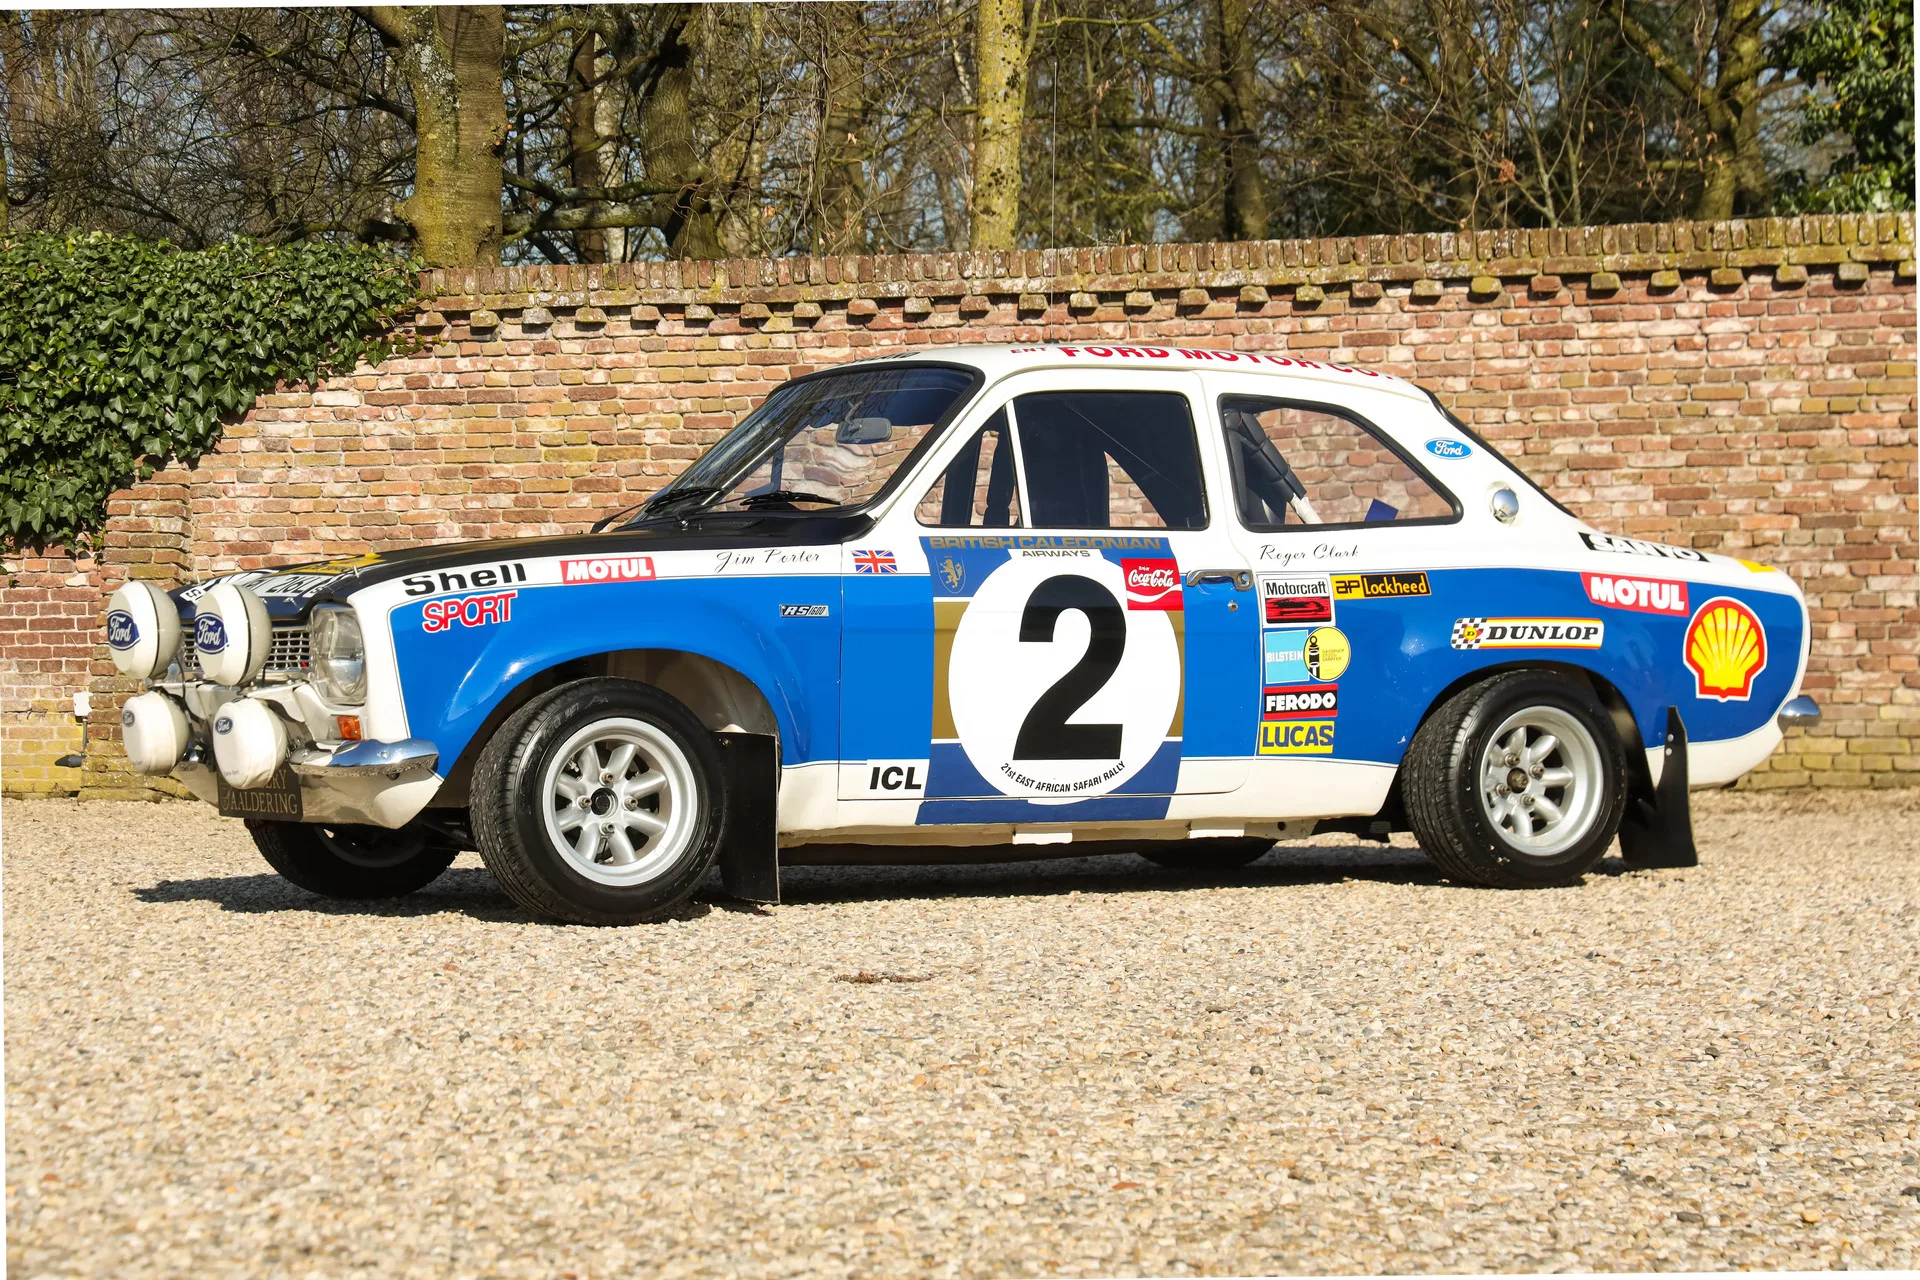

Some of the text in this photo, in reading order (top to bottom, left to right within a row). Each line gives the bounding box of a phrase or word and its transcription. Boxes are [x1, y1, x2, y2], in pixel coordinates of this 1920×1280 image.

[1058, 346, 1170, 358] FORD
[1177, 348, 1321, 369] MOTOR
[1434, 440, 1464, 456] Ford
[929, 536, 1161, 549] BRITISH CALEDONIAN
[1022, 549, 1091, 558] AIRWAYS
[1588, 533, 1701, 562] SANYO
[714, 549, 820, 573] Jim Porter
[1259, 543, 1359, 567] Roger Clark
[402, 563, 527, 596] Shell
[565, 558, 652, 581] MOTUL
[1128, 569, 1174, 588] Coca-Cola
[1265, 581, 1328, 596] Motorcraft
[1363, 575, 1427, 595] Lockheed
[1590, 576, 1685, 611] MOTUL
[423, 591, 517, 632] SPORT
[109, 615, 132, 642] Ford
[197, 618, 222, 646] Ford
[1486, 625, 1599, 640] DUNLOP
[1013, 574, 1127, 761] 2
[1266, 650, 1304, 663] BILSTEIN
[1265, 692, 1337, 712] FERODO
[1262, 724, 1334, 748] LUCAS
[869, 766, 922, 790] ICL
[1001, 761, 1126, 793] 21st EAST AFRICAN SAFARI RALLY
[231, 791, 298, 814] AALDERING
